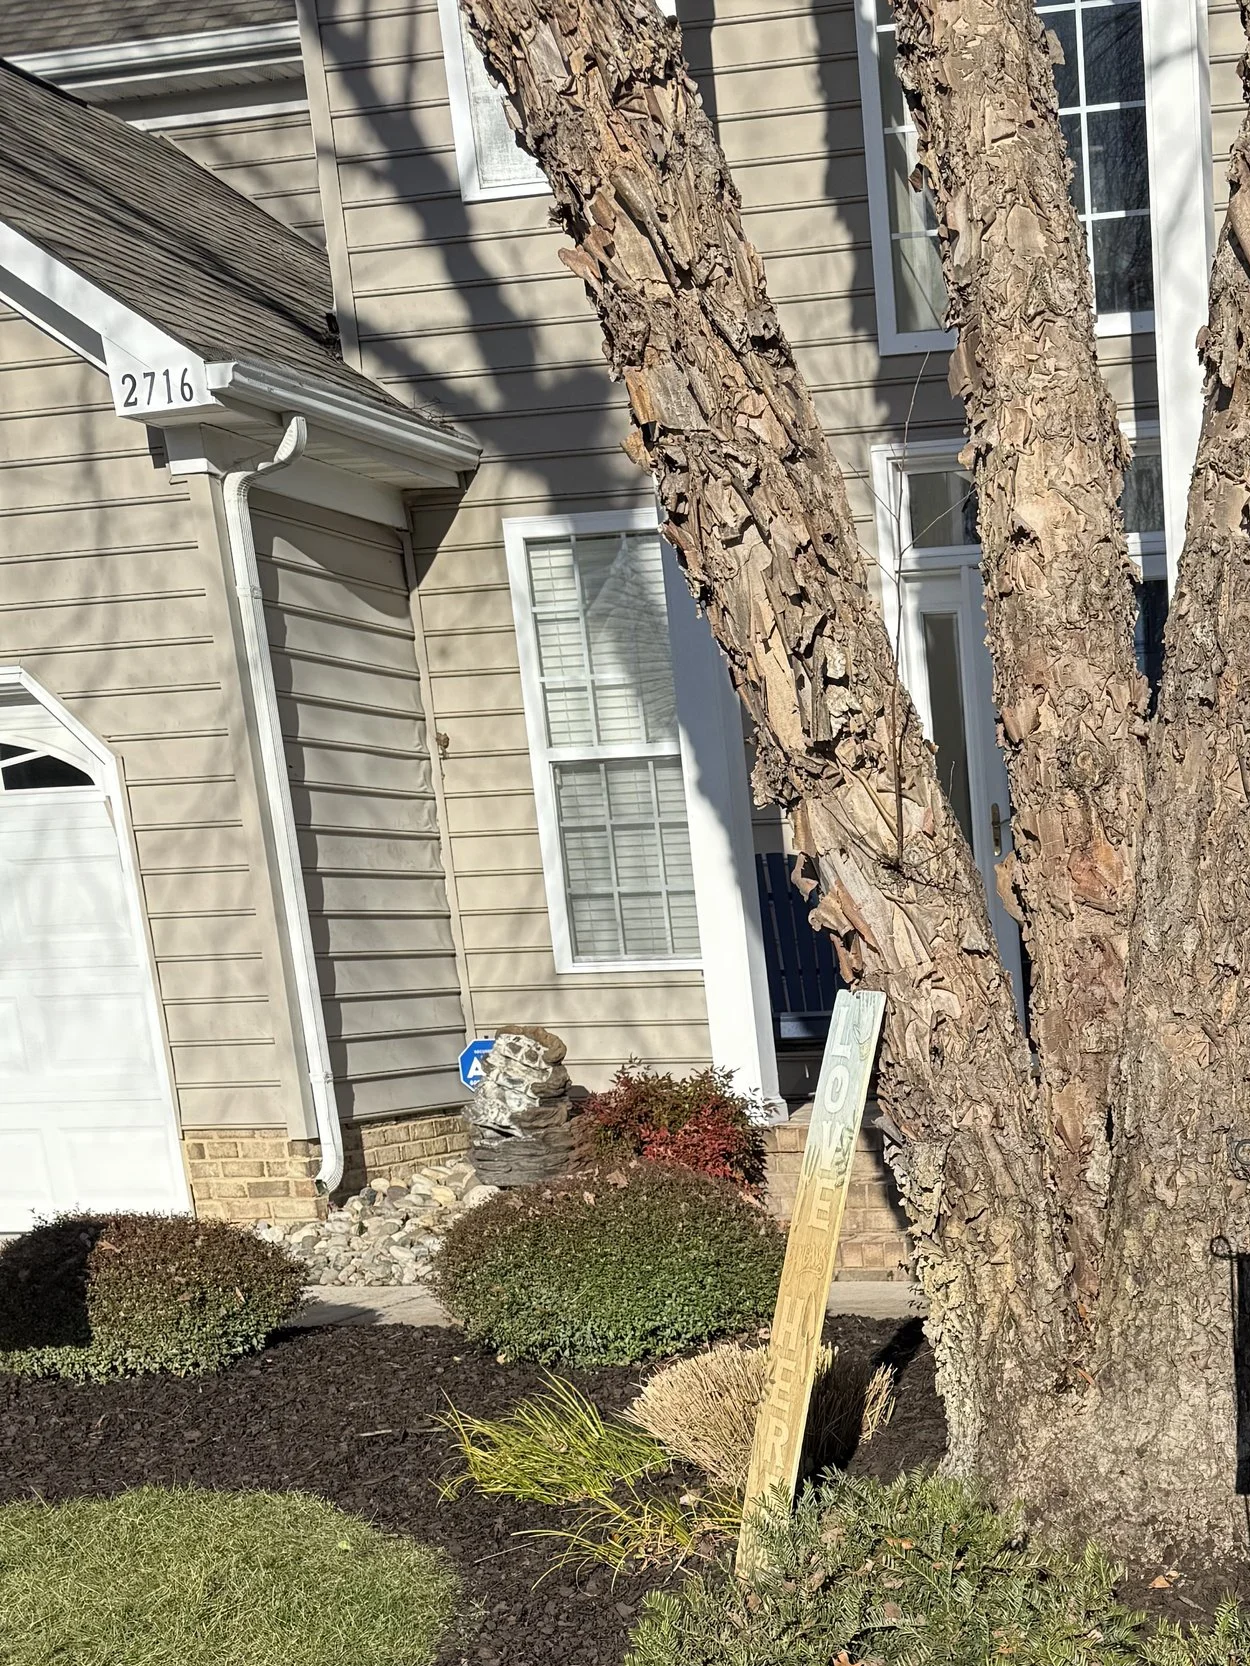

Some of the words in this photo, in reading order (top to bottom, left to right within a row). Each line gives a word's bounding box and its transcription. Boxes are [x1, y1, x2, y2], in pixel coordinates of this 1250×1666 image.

[121, 367, 194, 407] 2716
[808, 1006, 852, 1232] LOVE
[760, 1295, 805, 1505] HER
